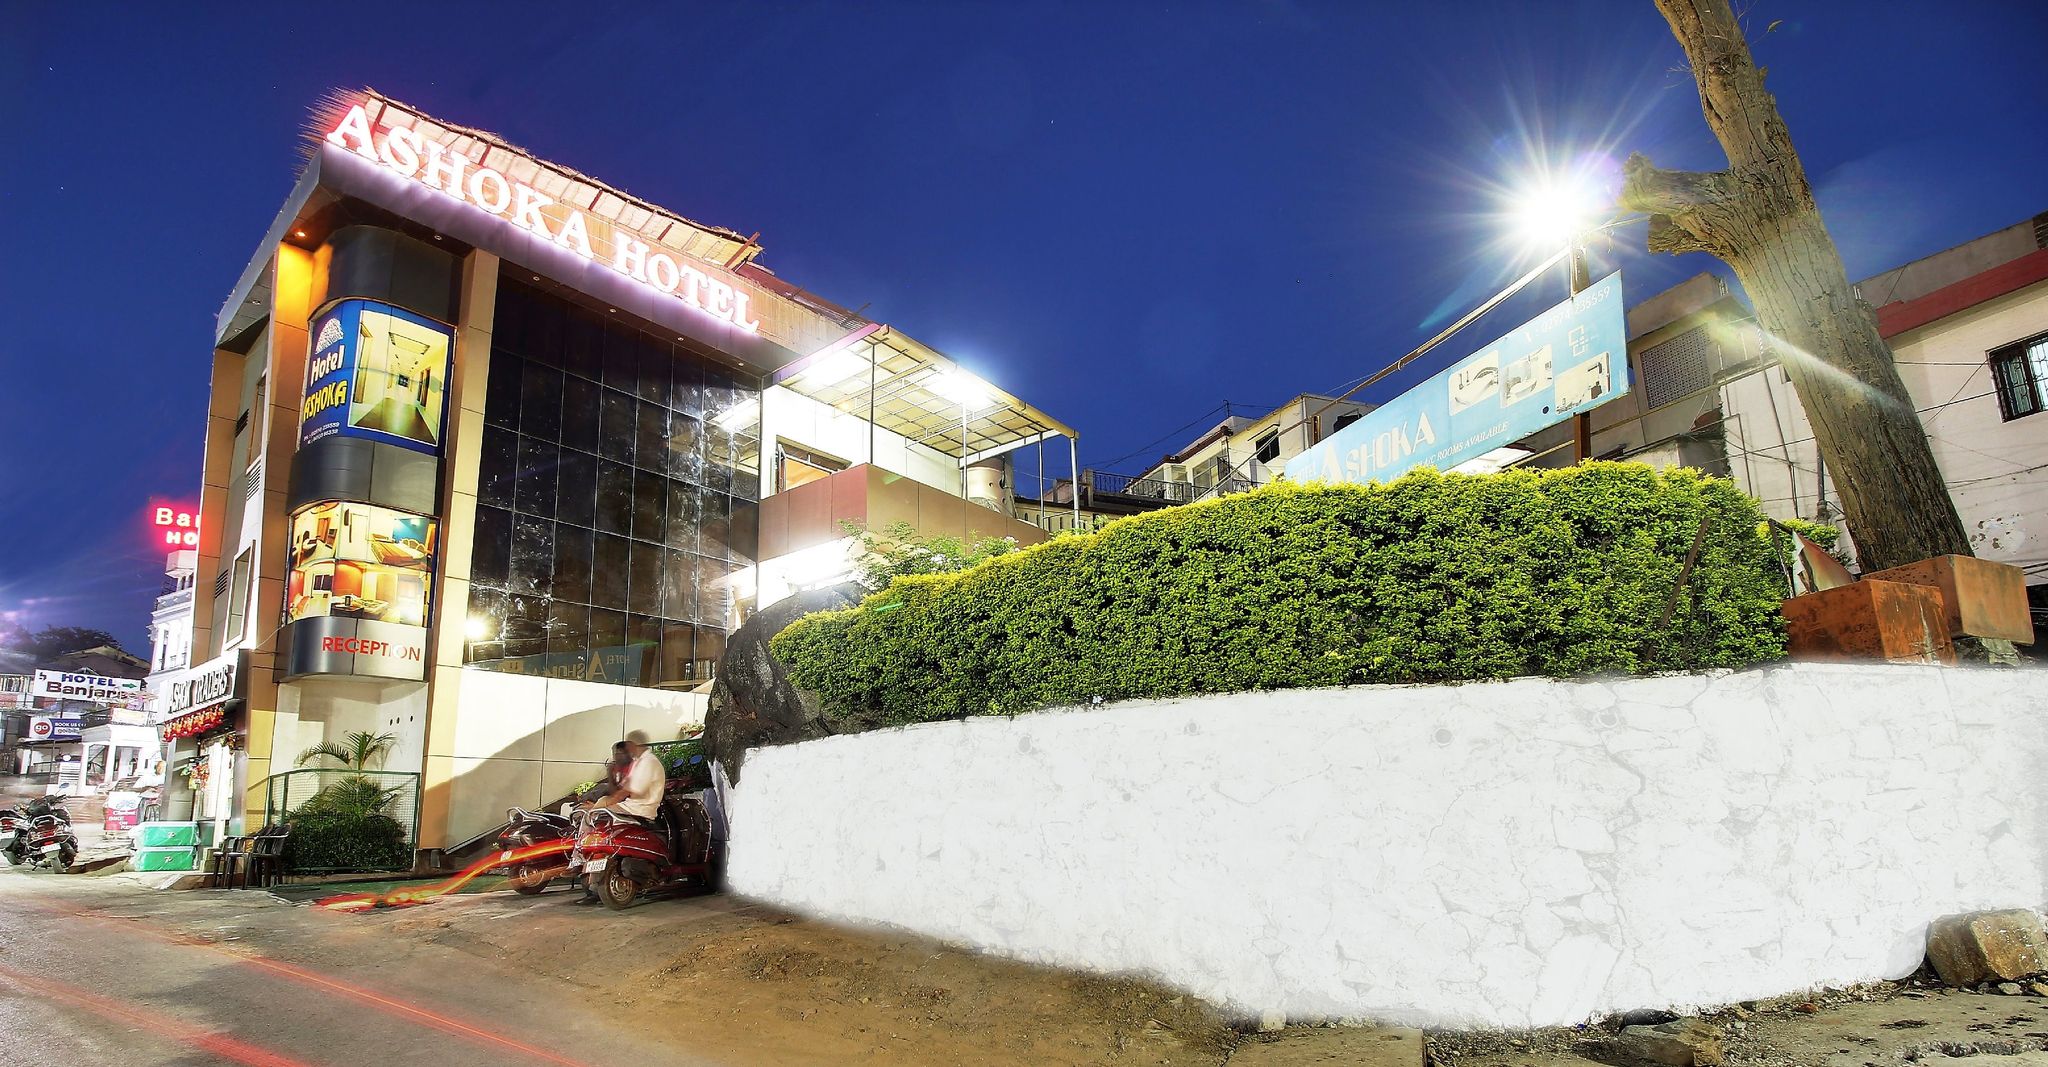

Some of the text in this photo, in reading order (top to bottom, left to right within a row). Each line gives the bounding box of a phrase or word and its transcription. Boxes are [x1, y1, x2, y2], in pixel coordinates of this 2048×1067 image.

[327, 105, 759, 334] ASHOKA HOTEL
[311, 345, 344, 387] Hotel
[303, 380, 347, 421] ASHOKA
[1321, 411, 1436, 484] ASHOKA
[1437, 441, 1464, 461] ROOMS
[1464, 420, 1510, 448] AVAILABLE
[322, 636, 420, 661] RECEPTION
[61, 673, 116, 687] HOTEL
